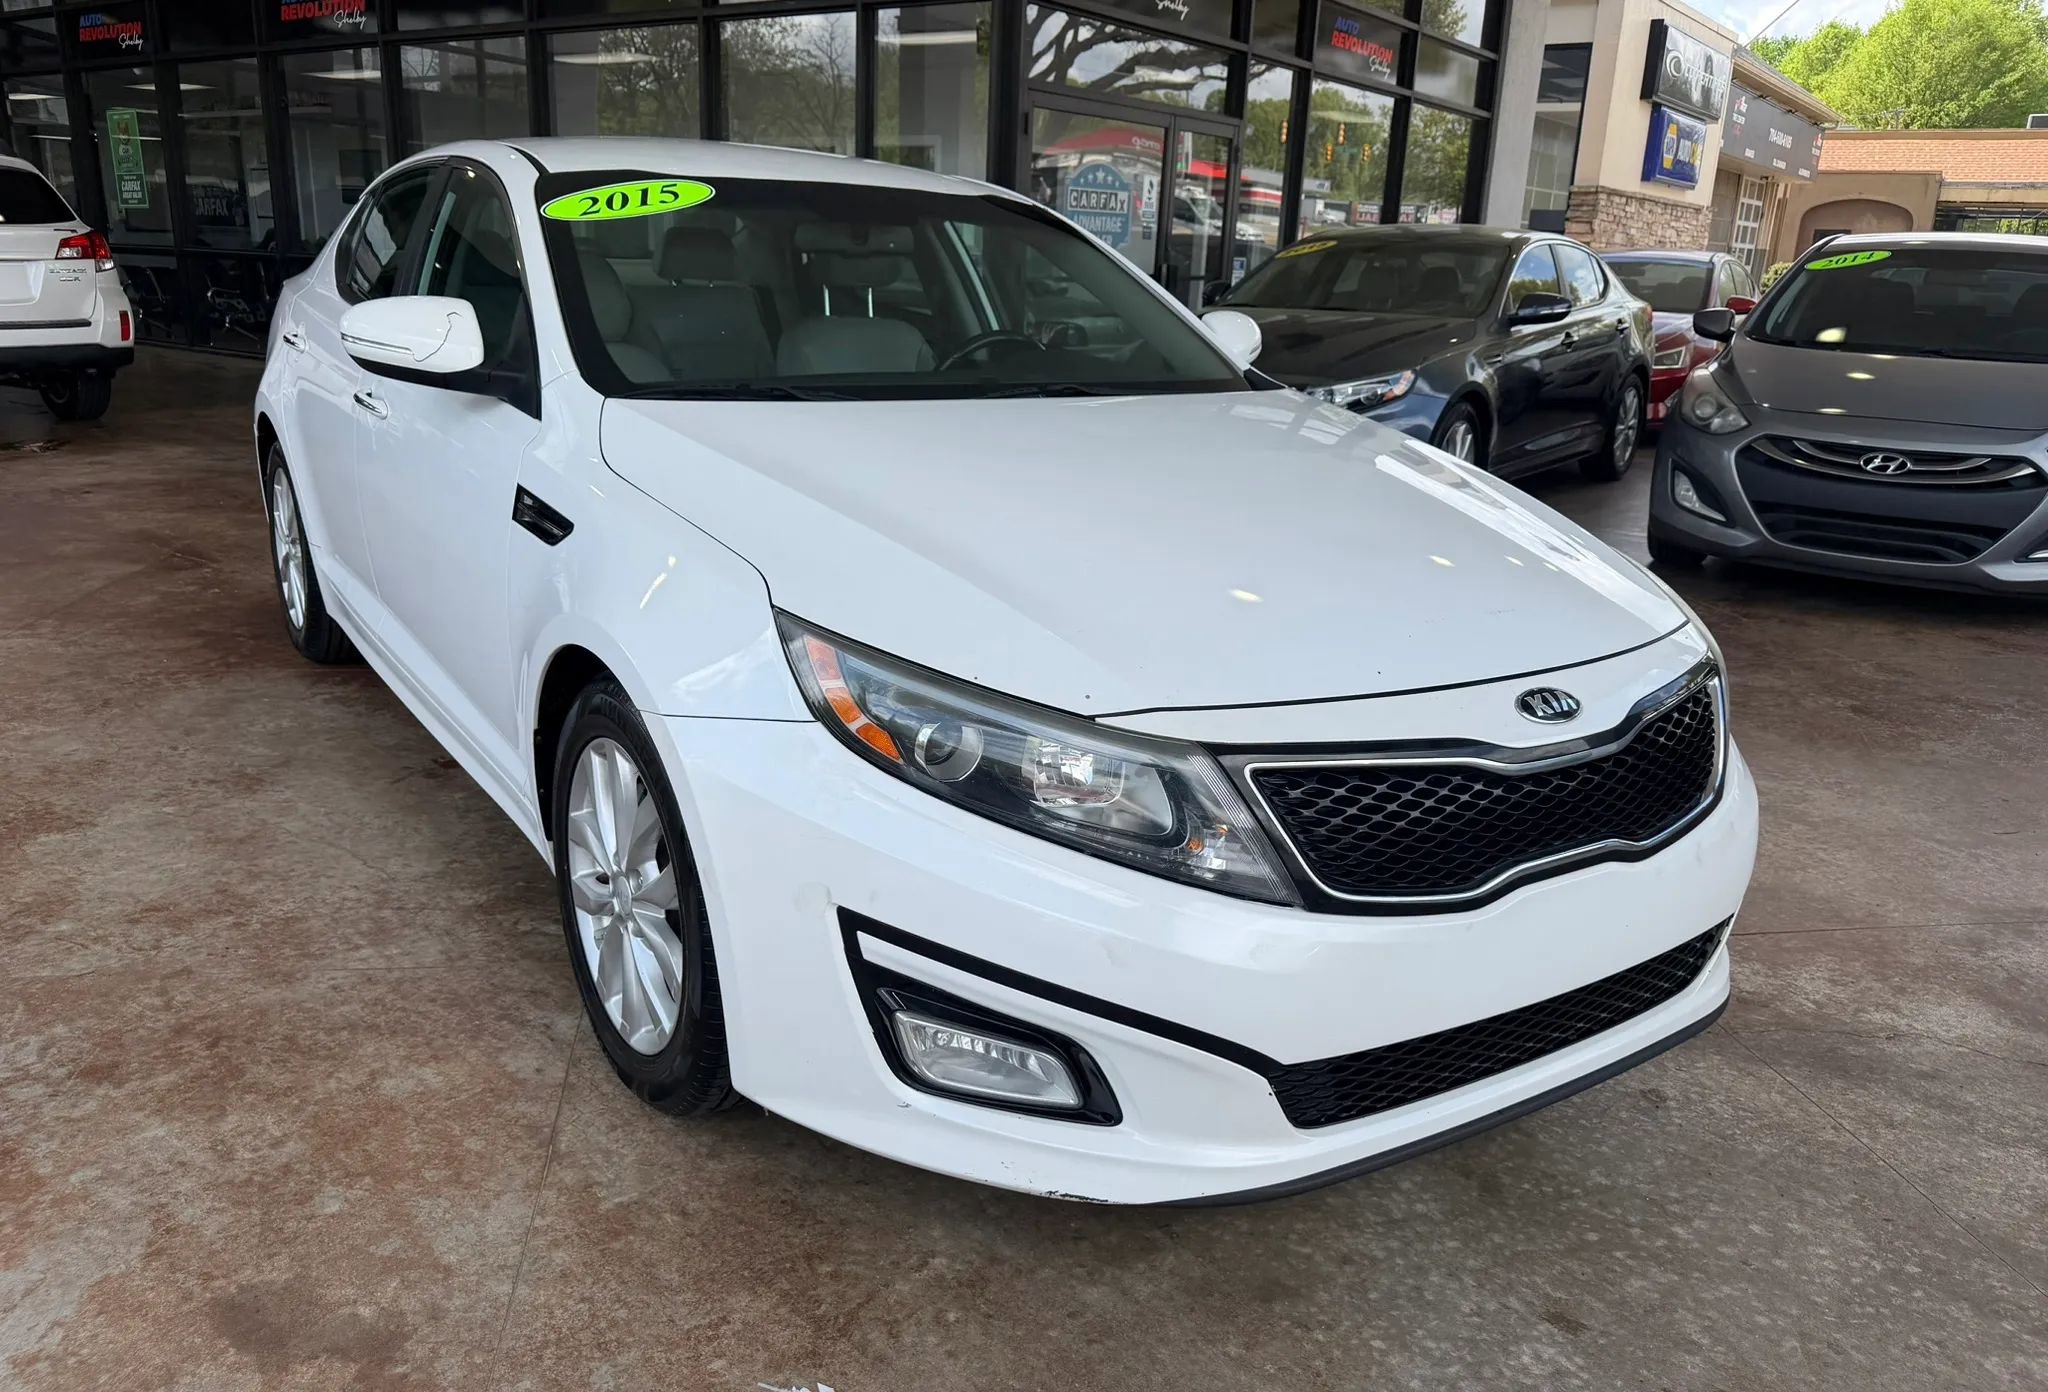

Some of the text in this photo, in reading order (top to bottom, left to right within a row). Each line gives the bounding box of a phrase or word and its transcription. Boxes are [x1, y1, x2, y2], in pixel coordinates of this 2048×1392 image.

[80, 14, 102, 27] AUTO
[281, 0, 365, 21] REVOLUTION
[334, 7, 367, 30] Shelby
[80, 21, 142, 41] REVOLUTION
[1334, 16, 1360, 35] AUTO
[119, 31, 144, 51] Shelby
[1331, 30, 1393, 64] REVOLUTION
[1369, 55, 1391, 80] Shelby
[121, 180, 141, 191] CARFAX
[578, 183, 679, 216] 2015
[1069, 190, 1126, 213] CARFAX
[1073, 213, 1124, 233] ADVANTAGE
[1821, 251, 1875, 268] 2014
[1523, 690, 1578, 717] KIA
